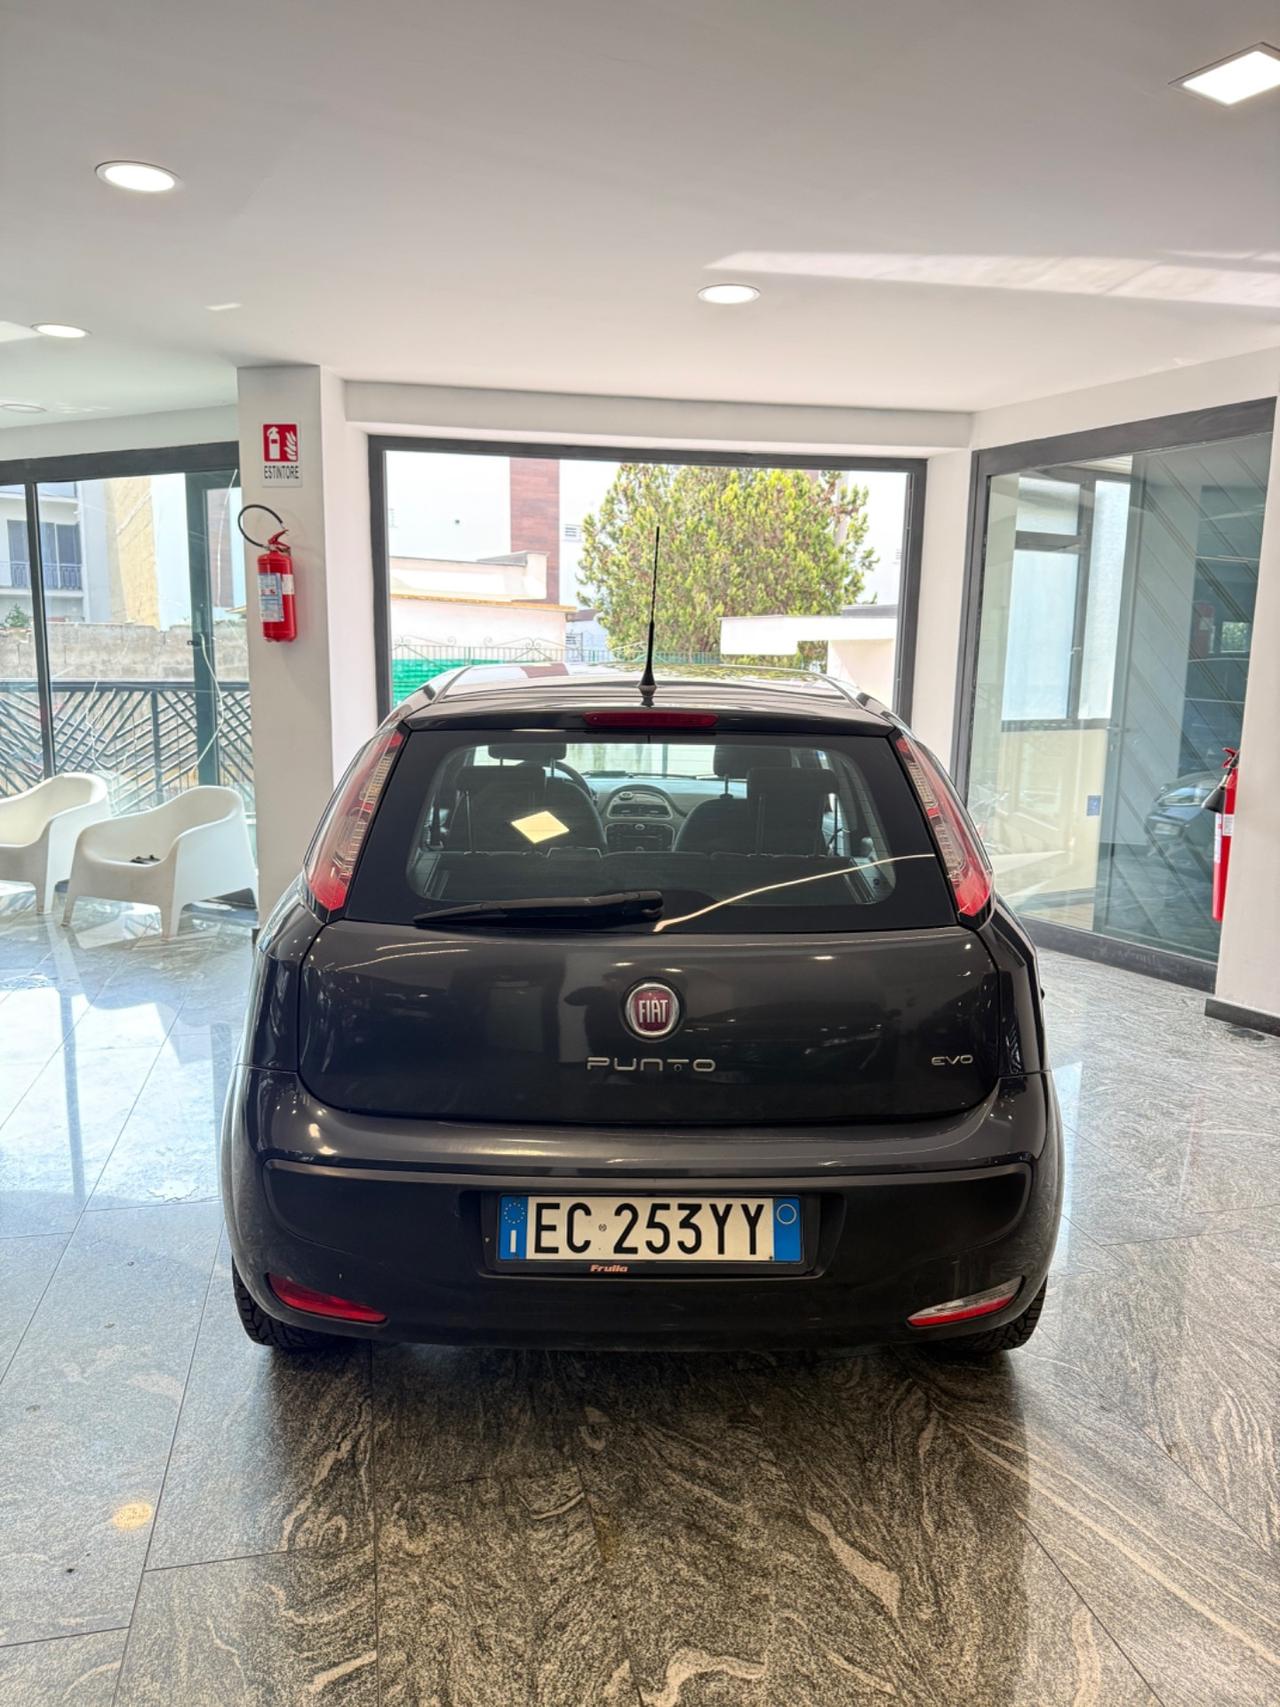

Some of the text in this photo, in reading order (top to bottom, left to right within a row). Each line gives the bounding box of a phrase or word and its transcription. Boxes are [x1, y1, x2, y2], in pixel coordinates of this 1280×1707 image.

[264, 465, 300, 480] ESTINTORE
[638, 999, 668, 1024] FIAT
[587, 1057, 716, 1072] PUNTO
[931, 1054, 974, 1066] EVO
[534, 1202, 765, 1255] EC 253YY
[510, 1229, 517, 1253] I
